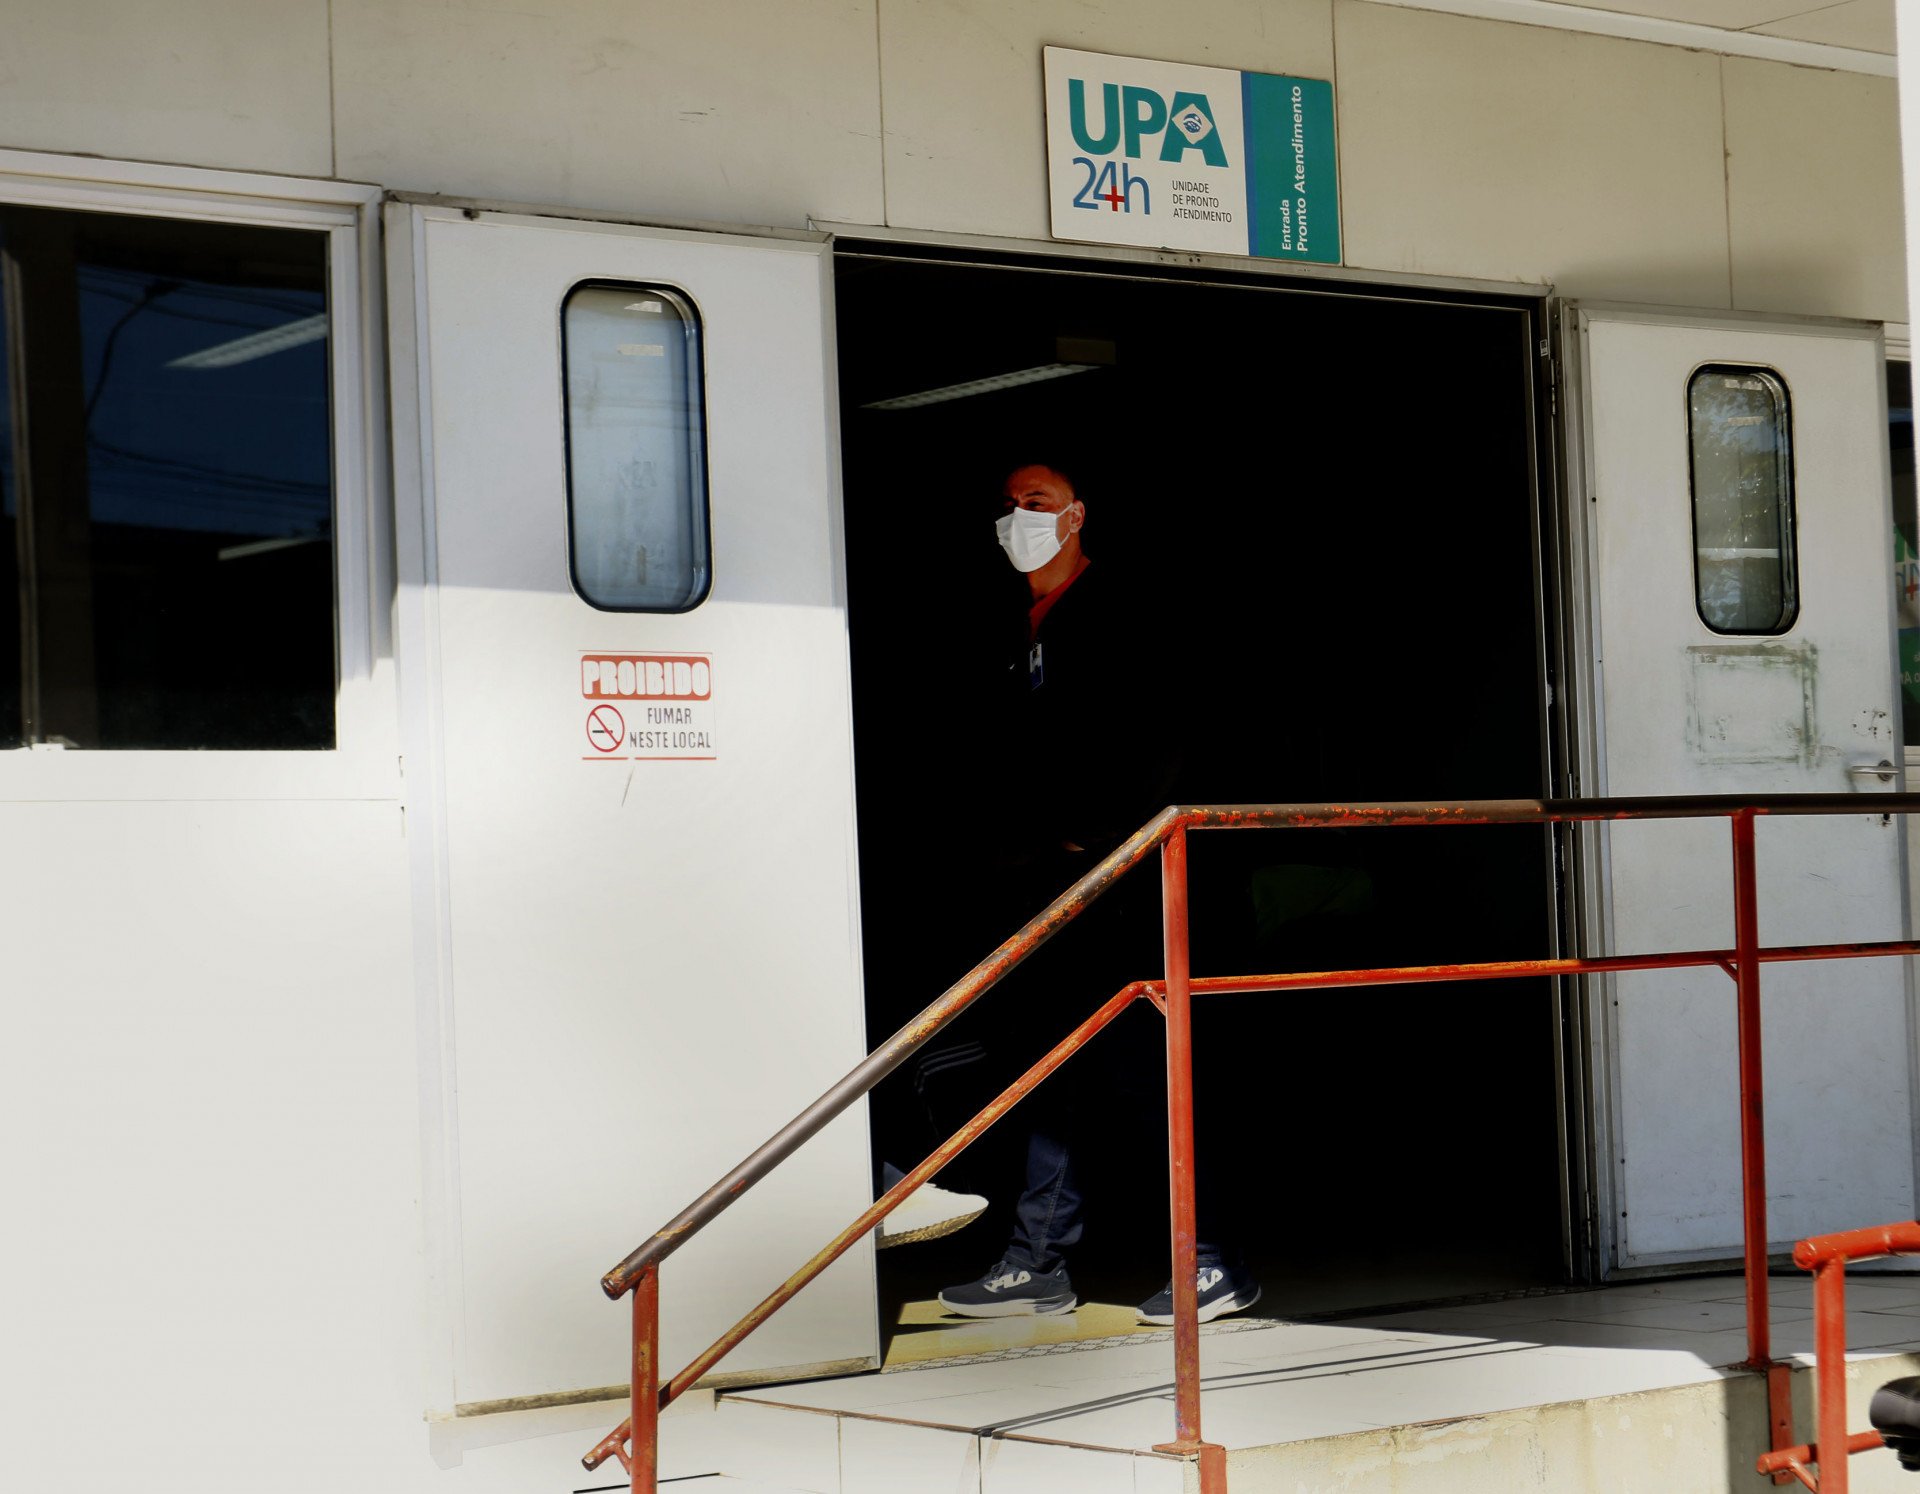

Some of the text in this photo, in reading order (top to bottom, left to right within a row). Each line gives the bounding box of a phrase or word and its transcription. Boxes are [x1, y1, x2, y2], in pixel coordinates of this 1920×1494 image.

[1068, 78, 1229, 168] UPA
[1291, 86, 1308, 252] Pronto Atendimento
[1072, 156, 1150, 215] 24h
[1171, 180, 1210, 194] UNIDADE
[1172, 193, 1219, 208] DE PRONTO
[1173, 208, 1232, 223] ATENDIMENTO
[1280, 199, 1292, 251] Entrada
[582, 660, 710, 696] PROIBIDO
[647, 707, 692, 724] FUMAR
[629, 731, 711, 748] NESTE LOCAL
